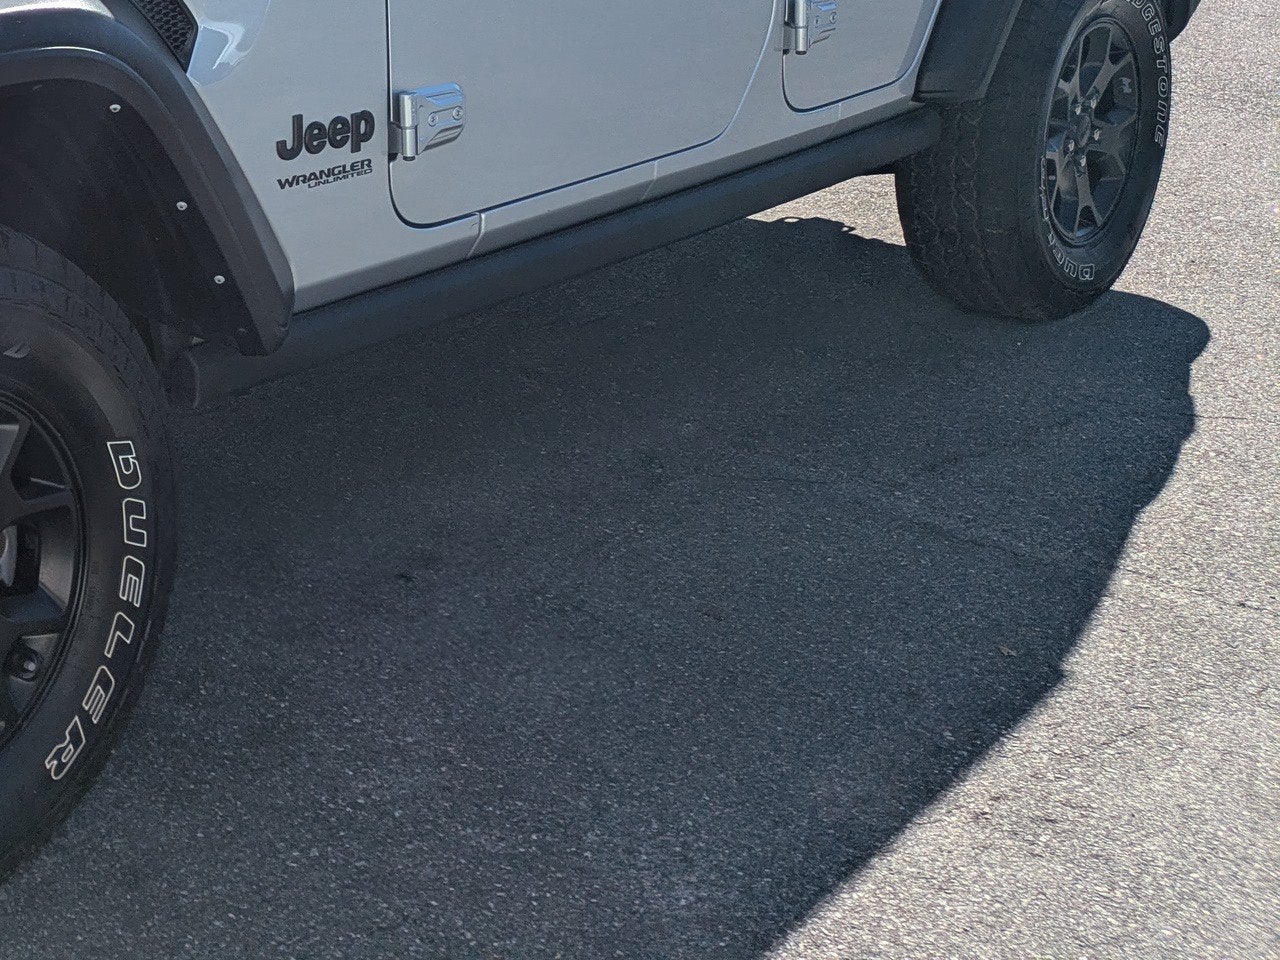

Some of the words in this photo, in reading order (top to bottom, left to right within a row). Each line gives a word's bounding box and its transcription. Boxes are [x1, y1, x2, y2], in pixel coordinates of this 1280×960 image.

[276, 109, 376, 161] Jeep
[276, 158, 373, 190] WRANGLER
[307, 168, 373, 189] UNLIMITED
[44, 440, 148, 781] DUELER
